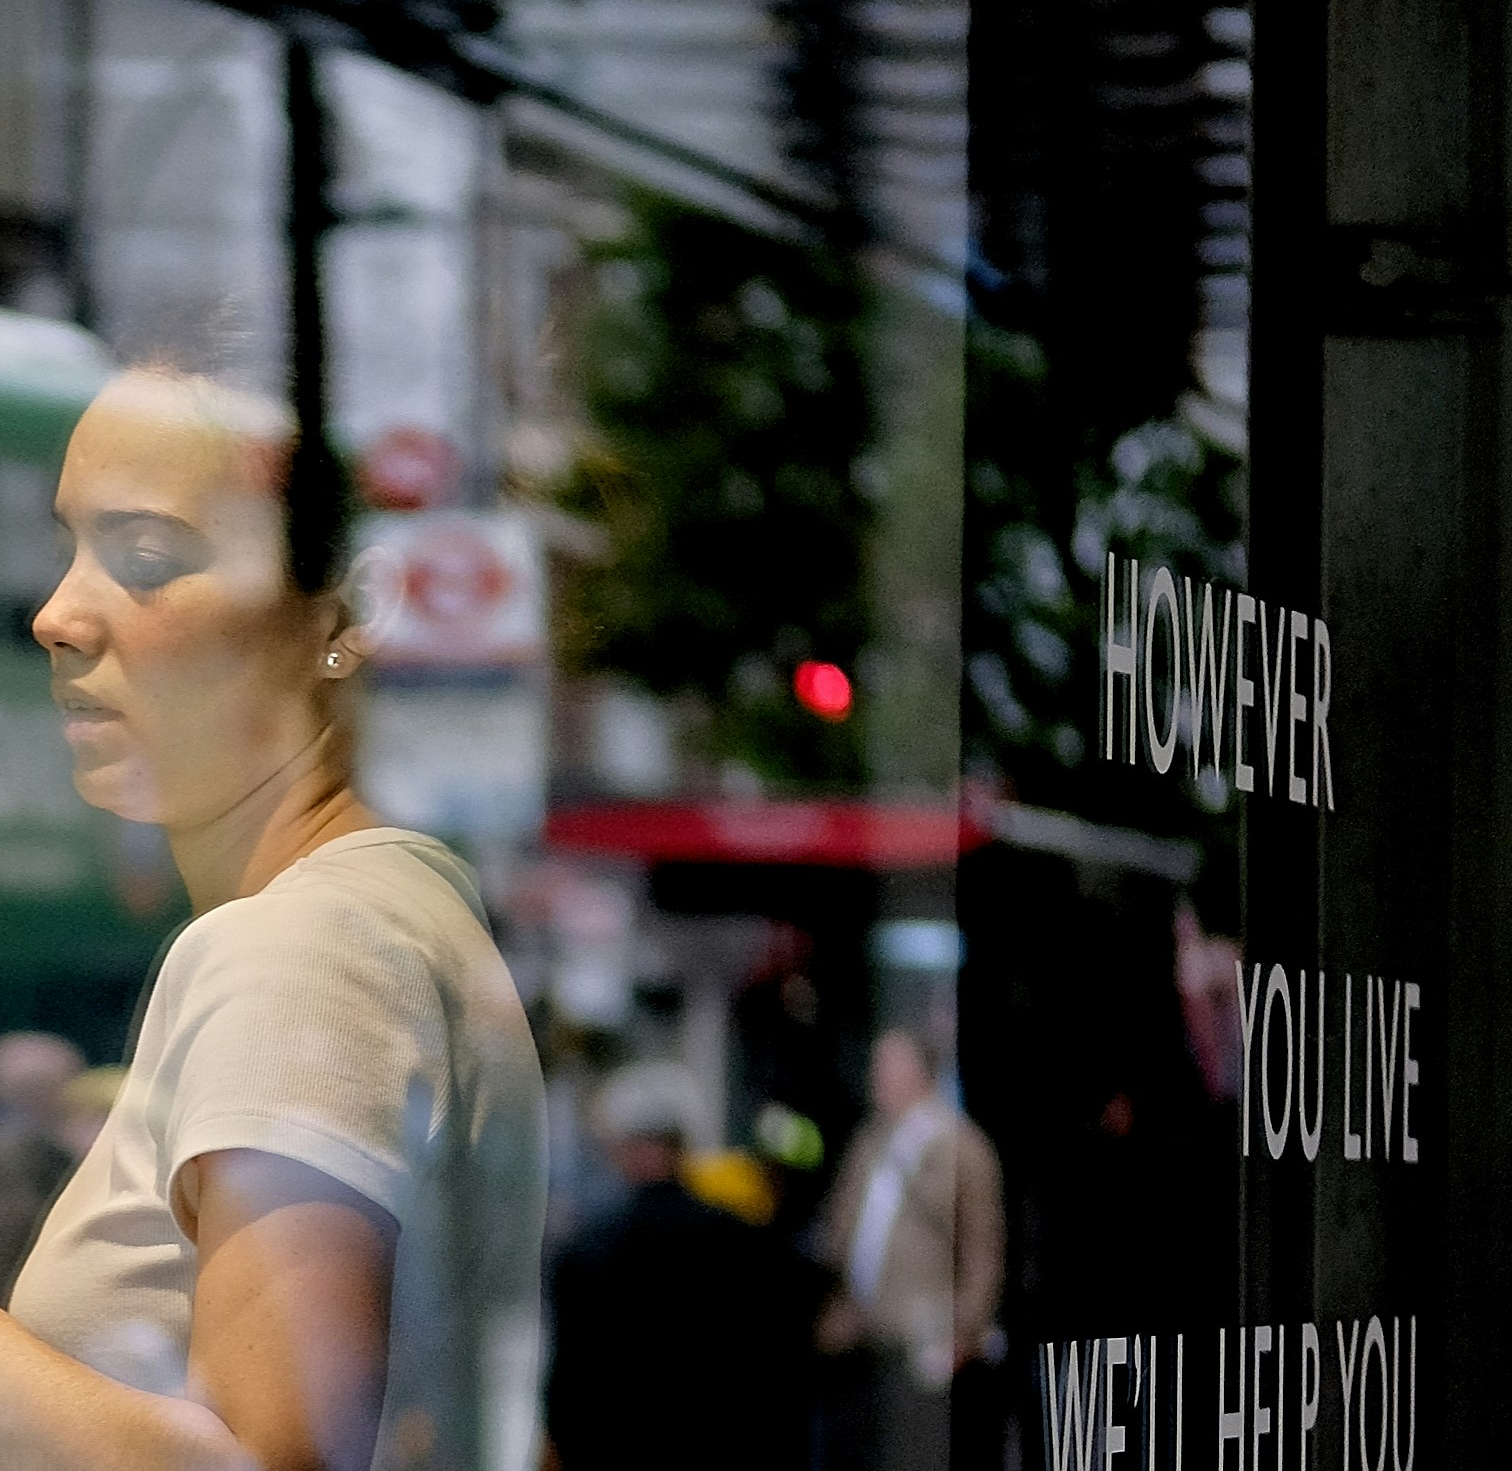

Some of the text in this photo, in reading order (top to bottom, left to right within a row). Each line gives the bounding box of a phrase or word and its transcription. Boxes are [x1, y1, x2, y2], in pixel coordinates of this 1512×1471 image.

[1106, 552, 1335, 811] HOWEVER
[1235, 960, 1420, 1163] YOU LIVE
